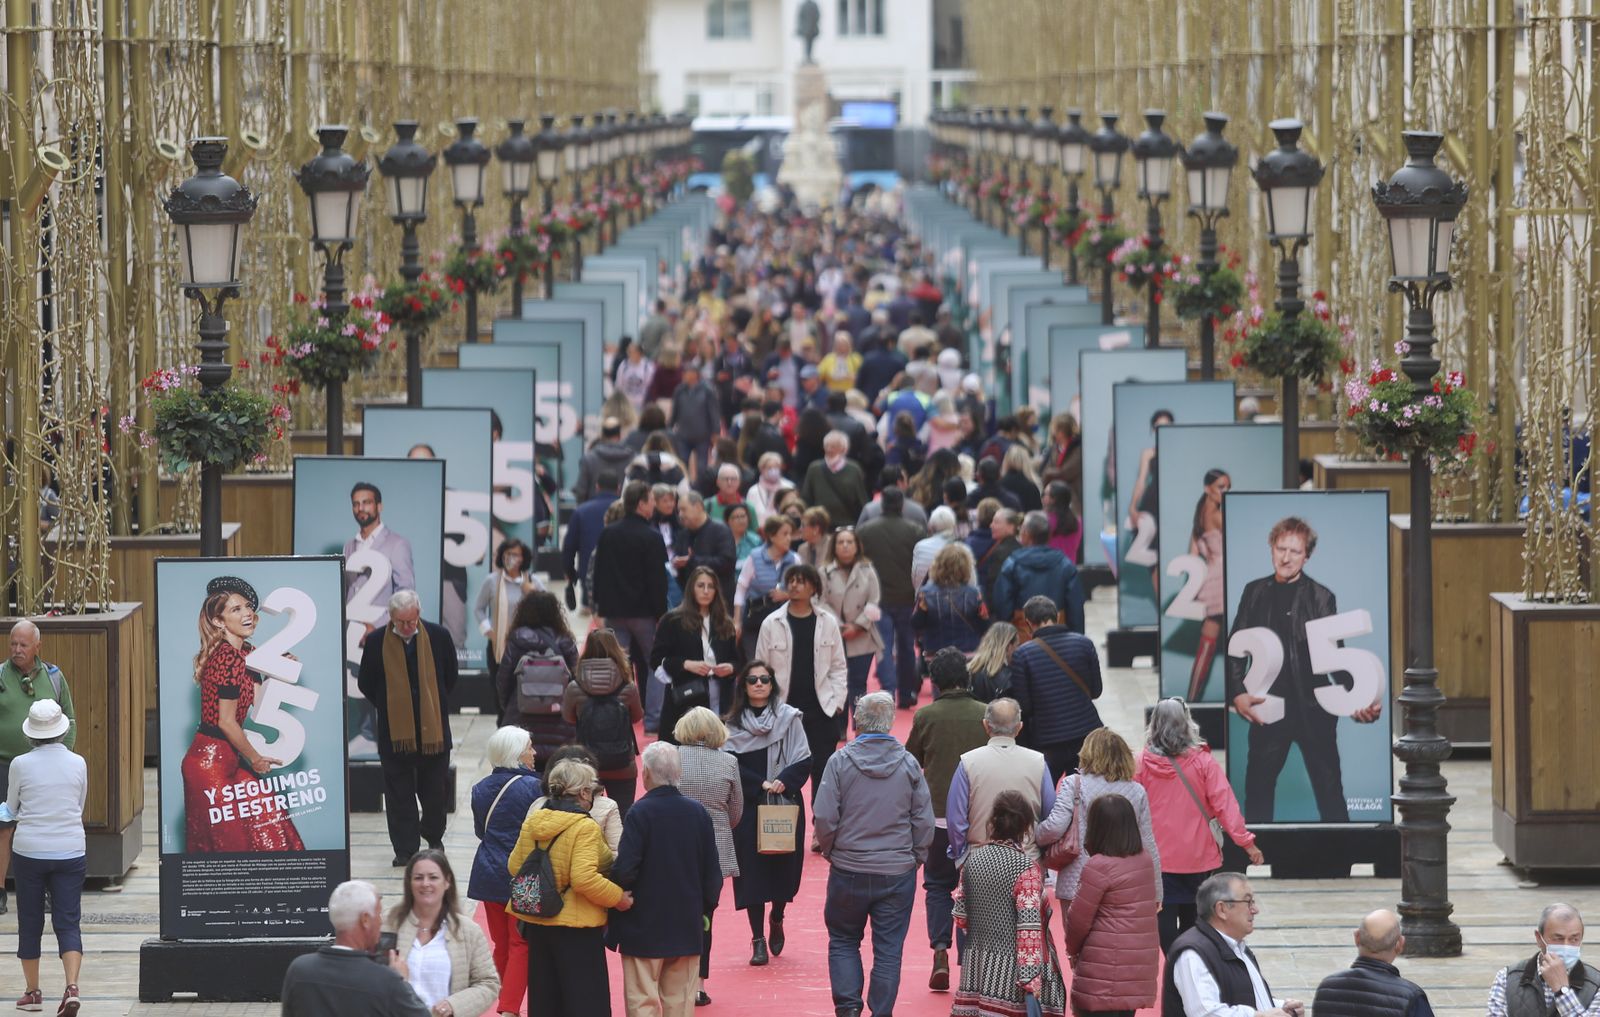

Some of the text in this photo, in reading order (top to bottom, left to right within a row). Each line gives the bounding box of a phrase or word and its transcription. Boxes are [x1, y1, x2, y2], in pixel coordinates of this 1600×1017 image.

[444, 489, 490, 567] 5
[1124, 511, 1158, 567] 2
[346, 549, 393, 623] 2
[1164, 554, 1208, 621] 2
[246, 586, 317, 684] 2
[243, 675, 320, 769] 5
[204, 768, 321, 805] Y SEGUIMOS
[208, 804, 236, 825] DE
[238, 787, 327, 818] ESTRENO
